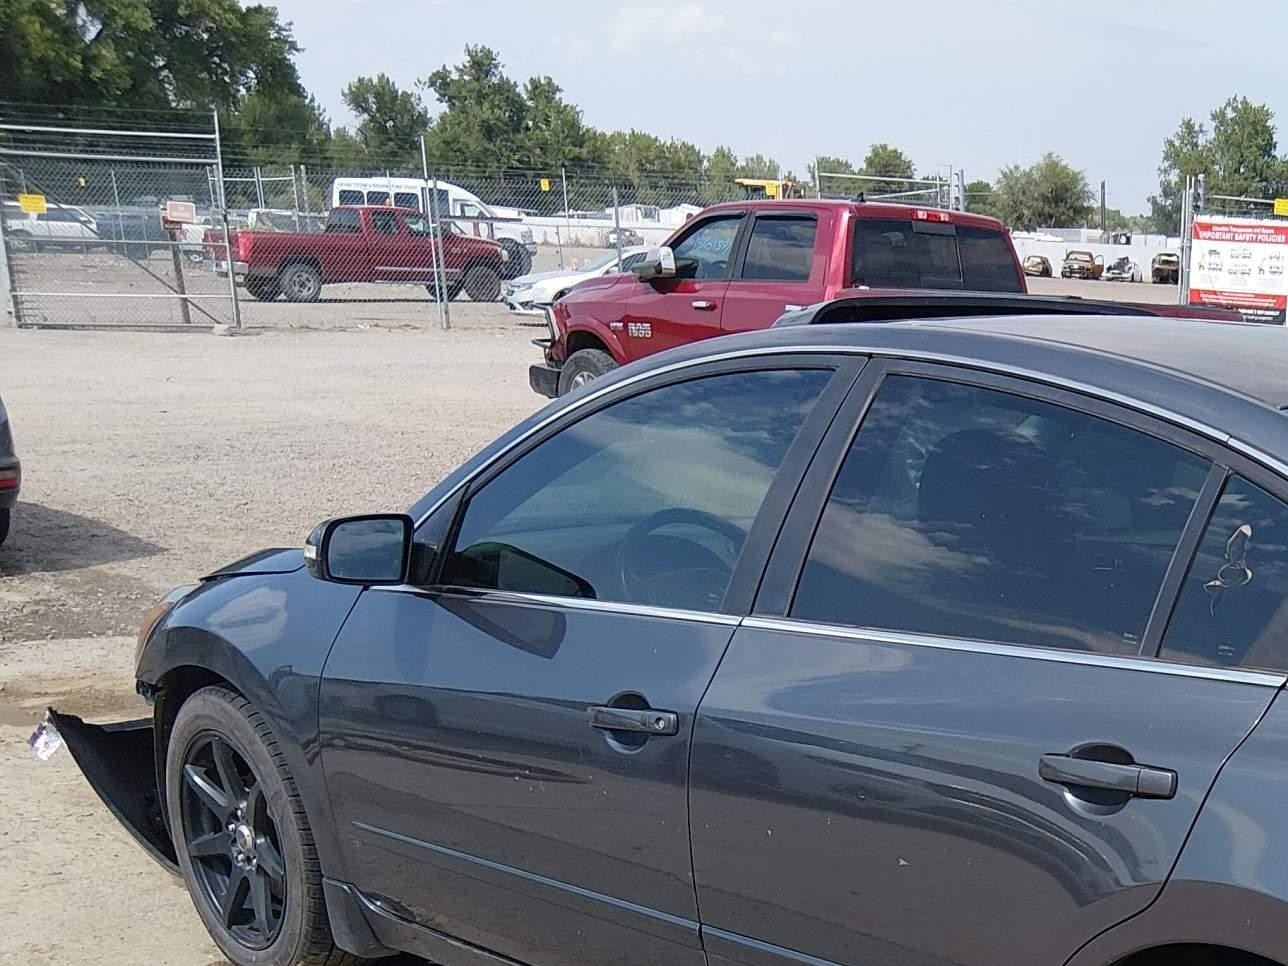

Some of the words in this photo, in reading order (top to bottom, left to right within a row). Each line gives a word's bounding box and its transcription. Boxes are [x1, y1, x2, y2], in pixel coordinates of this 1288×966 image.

[1199, 230, 1234, 240] IMPORTANT
[1234, 232, 1257, 241] SAFETY
[1257, 233, 1286, 242] POLICIES
